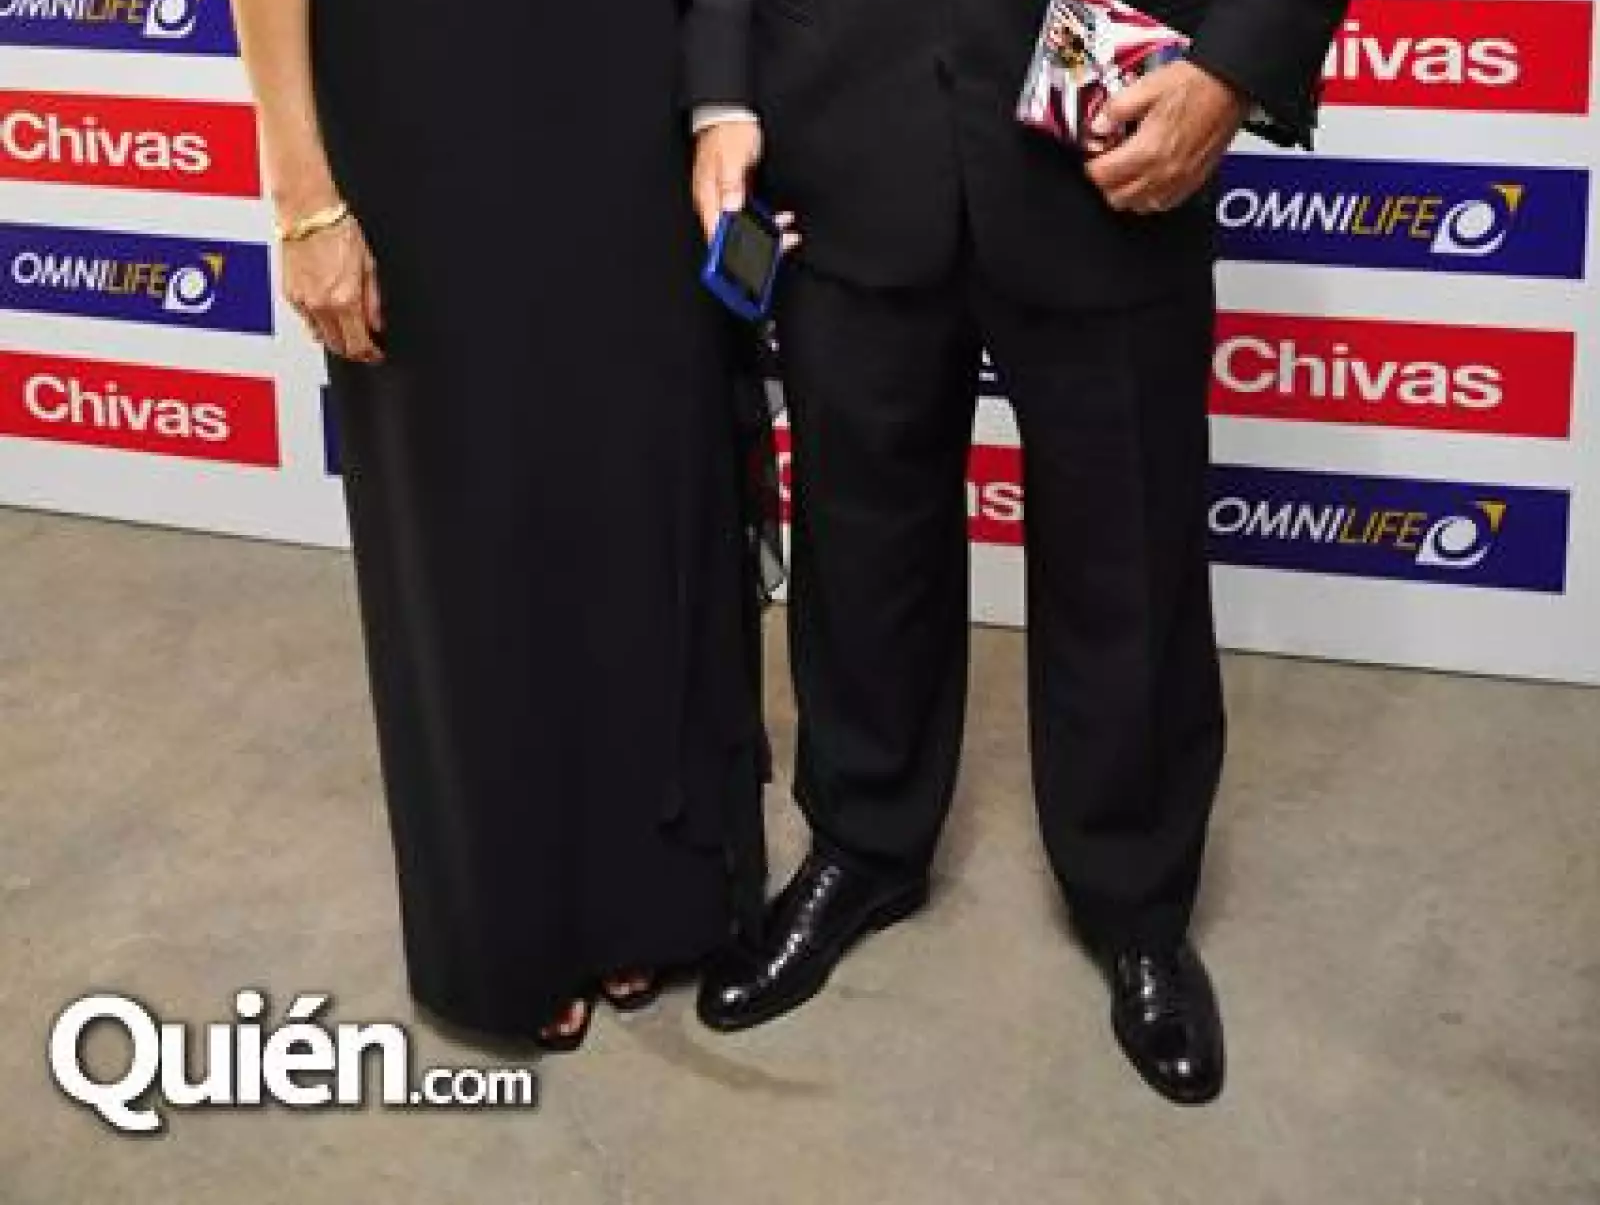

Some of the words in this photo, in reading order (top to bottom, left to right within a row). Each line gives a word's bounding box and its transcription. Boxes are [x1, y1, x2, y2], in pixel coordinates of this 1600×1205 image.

[1321, 19, 1522, 85] ivas
[0, 109, 212, 174] Chivas
[1215, 187, 1444, 240] OMNILIFE
[10, 252, 169, 298] OMNILIFE
[1211, 334, 1504, 410] Chivas
[23, 372, 231, 442] Chivas
[1207, 496, 1428, 551] OMNILIFE
